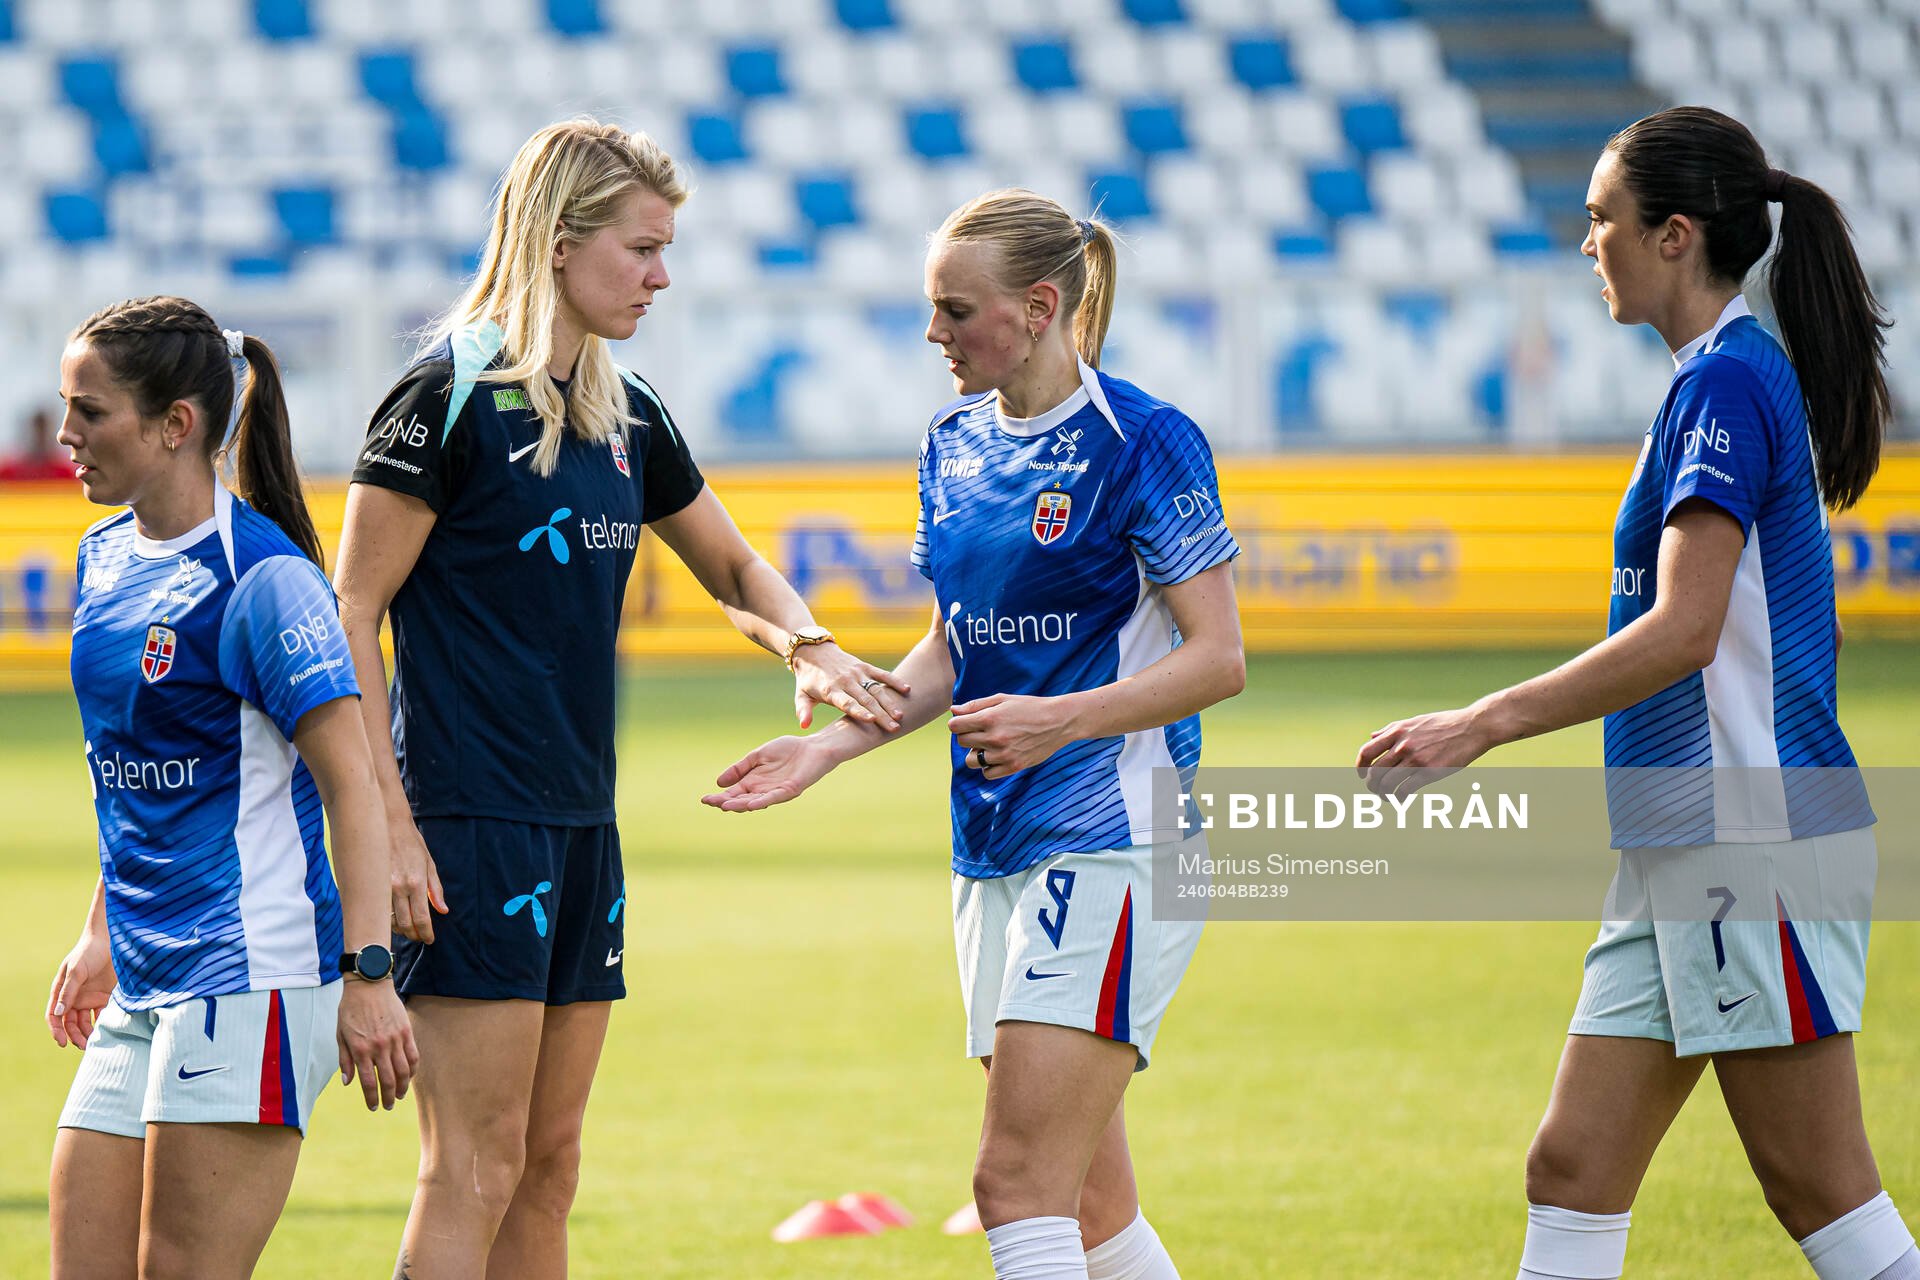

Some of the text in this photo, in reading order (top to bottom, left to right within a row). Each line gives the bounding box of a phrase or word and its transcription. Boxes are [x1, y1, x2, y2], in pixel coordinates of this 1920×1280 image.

[379, 414, 429, 447] DNB
[1683, 418, 1730, 455] DNB
[1028, 461, 1056, 471] Norsk
[1173, 486, 1214, 519] DN
[580, 514, 638, 550] teleno
[1180, 522, 1227, 548] #huninve
[280, 609, 328, 655] DNB
[965, 608, 1078, 645] telenor
[1037, 868, 1077, 951] 9
[1706, 886, 1738, 974] 7
